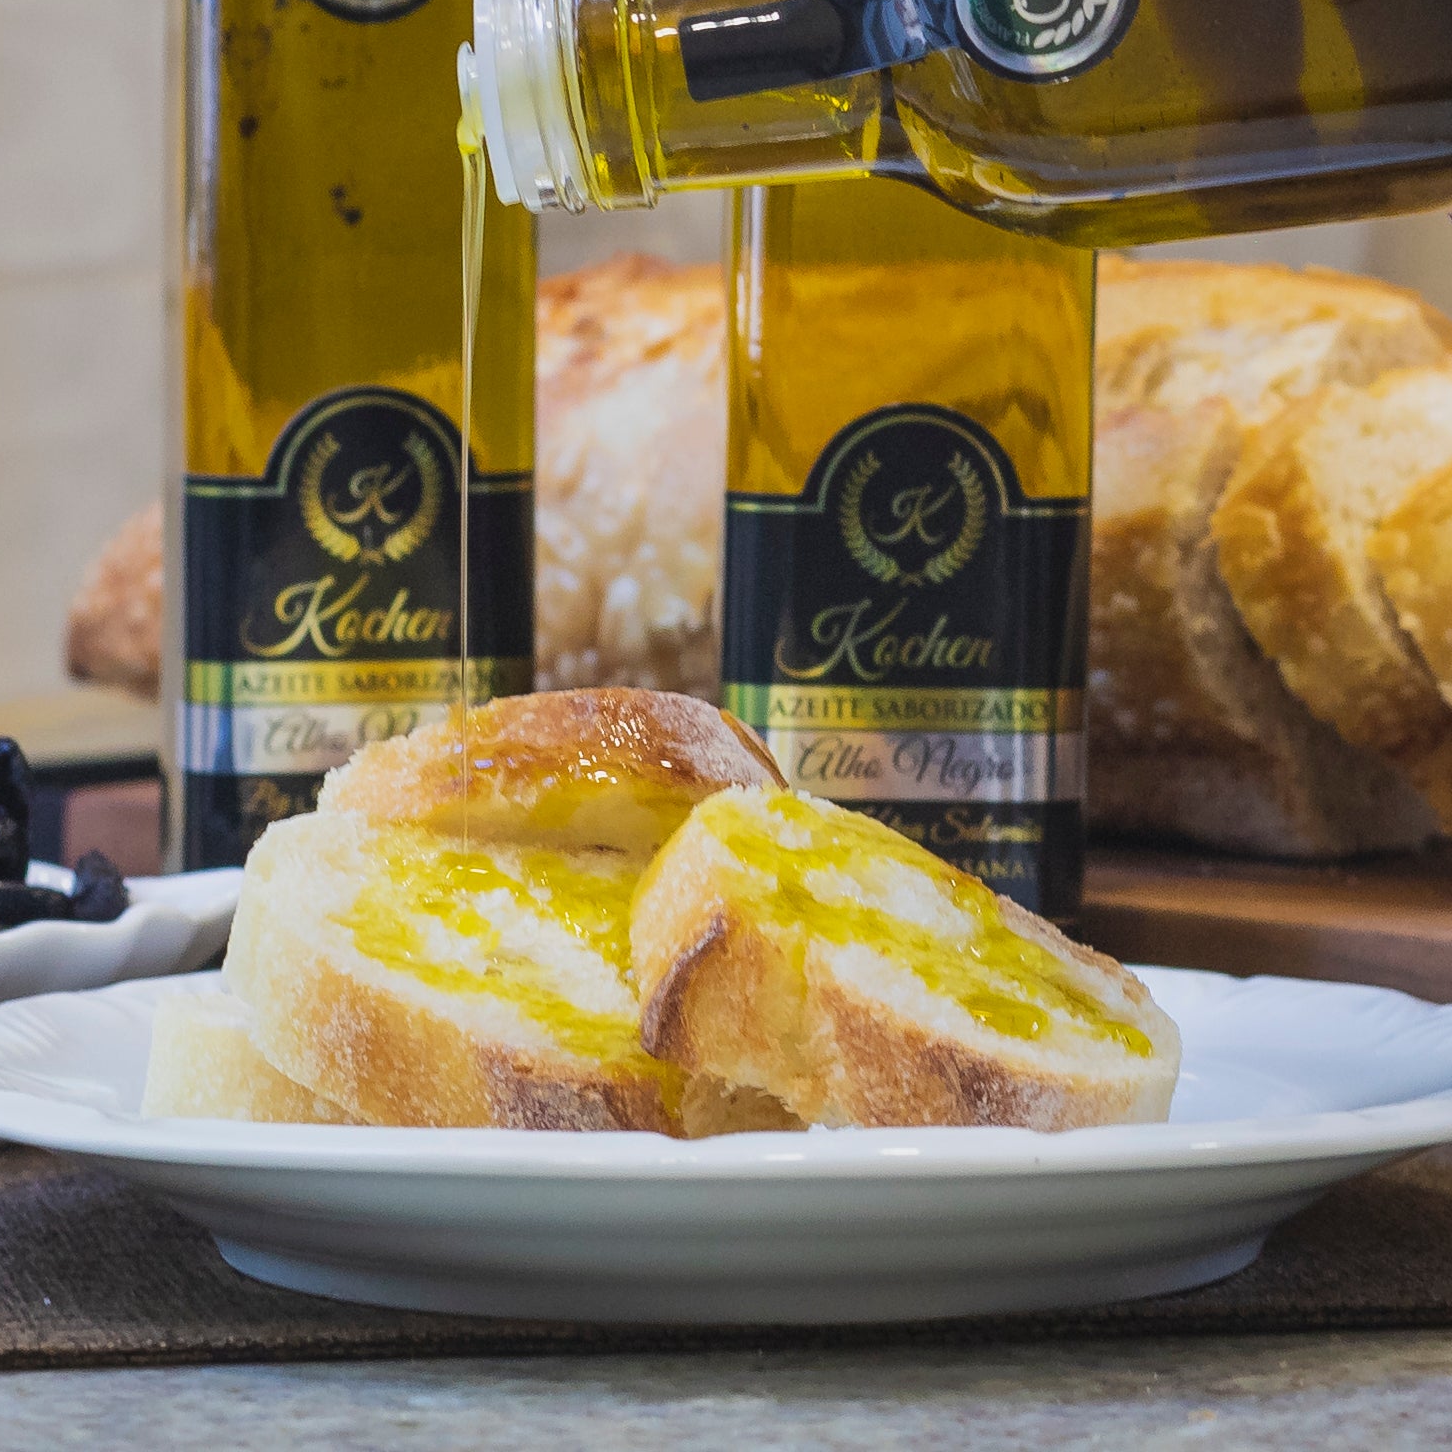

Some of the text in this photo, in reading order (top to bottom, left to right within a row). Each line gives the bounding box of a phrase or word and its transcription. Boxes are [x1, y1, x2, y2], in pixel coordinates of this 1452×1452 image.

[239, 572, 455, 658] Kochen
[773, 598, 994, 682] Kochen
[771, 697, 861, 719] AZEITE
[797, 735, 1016, 797] Alho Negro
